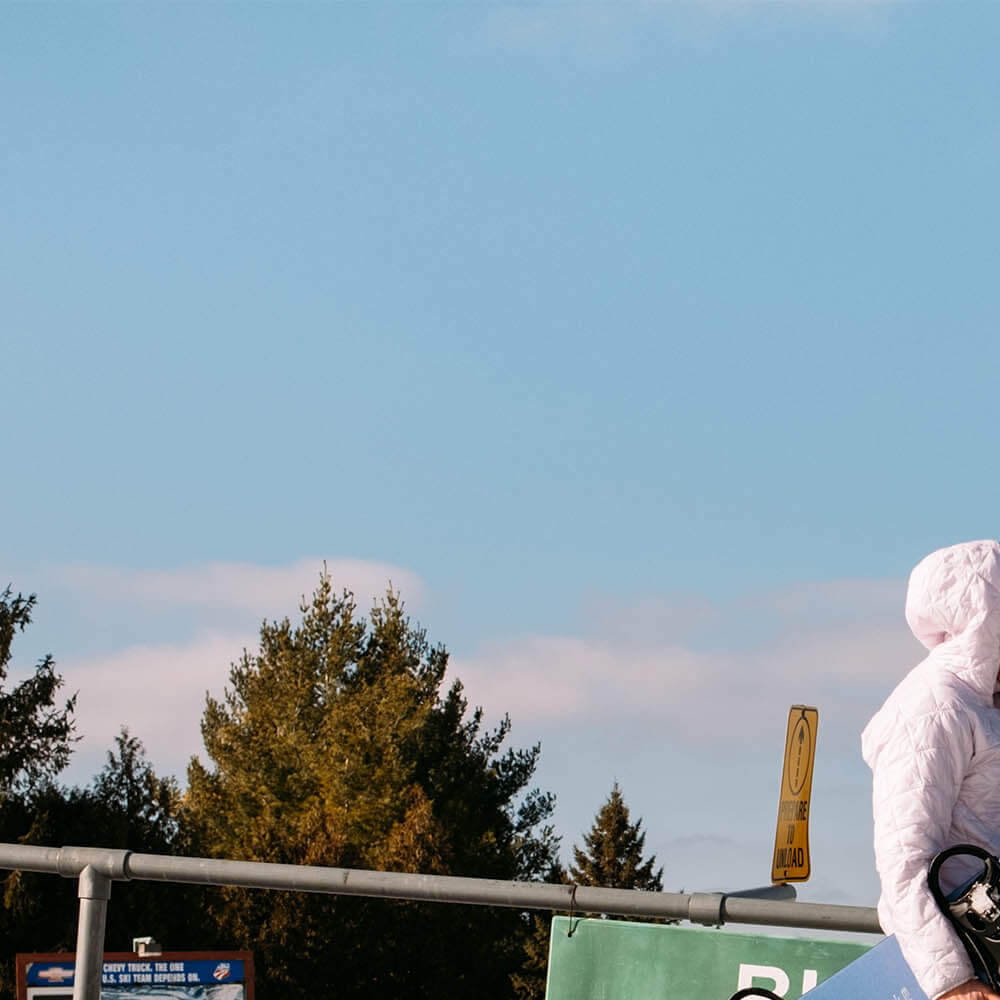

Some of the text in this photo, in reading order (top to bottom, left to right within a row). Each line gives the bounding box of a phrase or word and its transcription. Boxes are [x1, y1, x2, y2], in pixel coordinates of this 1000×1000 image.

[776, 847, 804, 869] UNLOAD
[103, 963, 126, 973] CHEVY
[155, 962, 168, 972] THE
[133, 973, 152, 983] TEAM
[154, 972, 186, 983] DEPENDS
